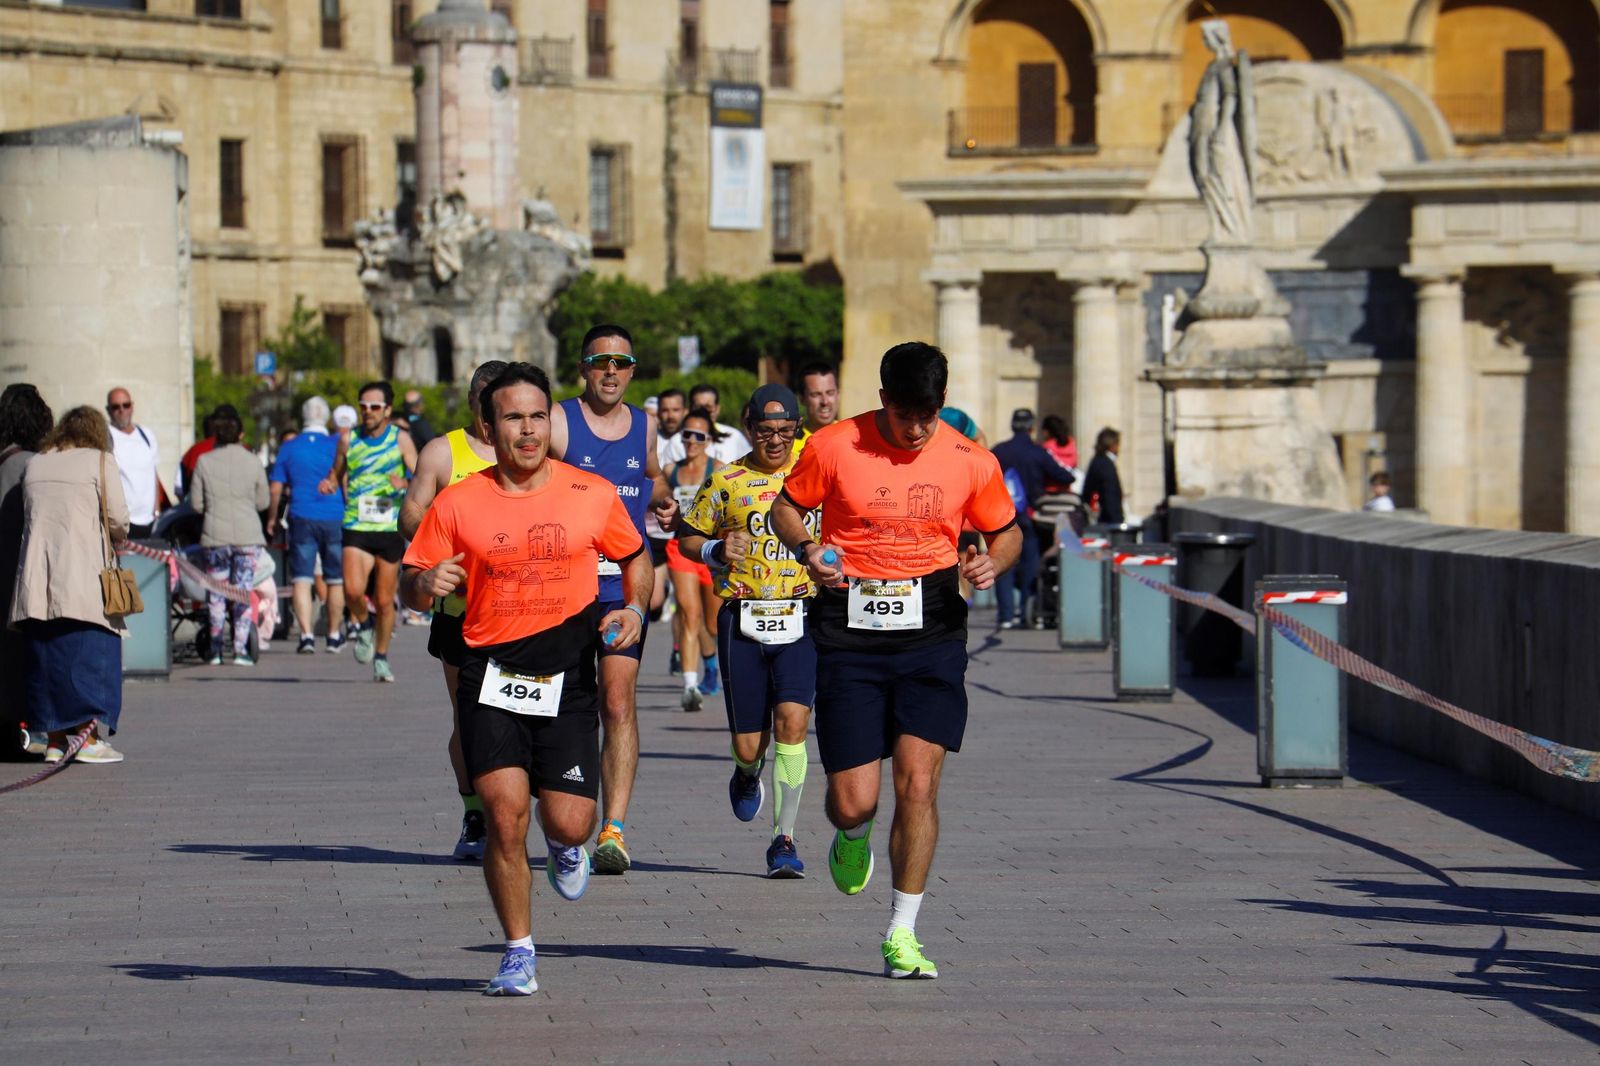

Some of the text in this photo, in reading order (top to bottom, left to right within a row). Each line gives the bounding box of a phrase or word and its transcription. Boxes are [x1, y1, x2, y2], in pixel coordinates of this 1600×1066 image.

[747, 479, 768, 488] POWER
[863, 600, 904, 615] 493
[756, 619, 787, 631] 321
[499, 682, 541, 701] 494
[562, 773, 584, 783] adidas
